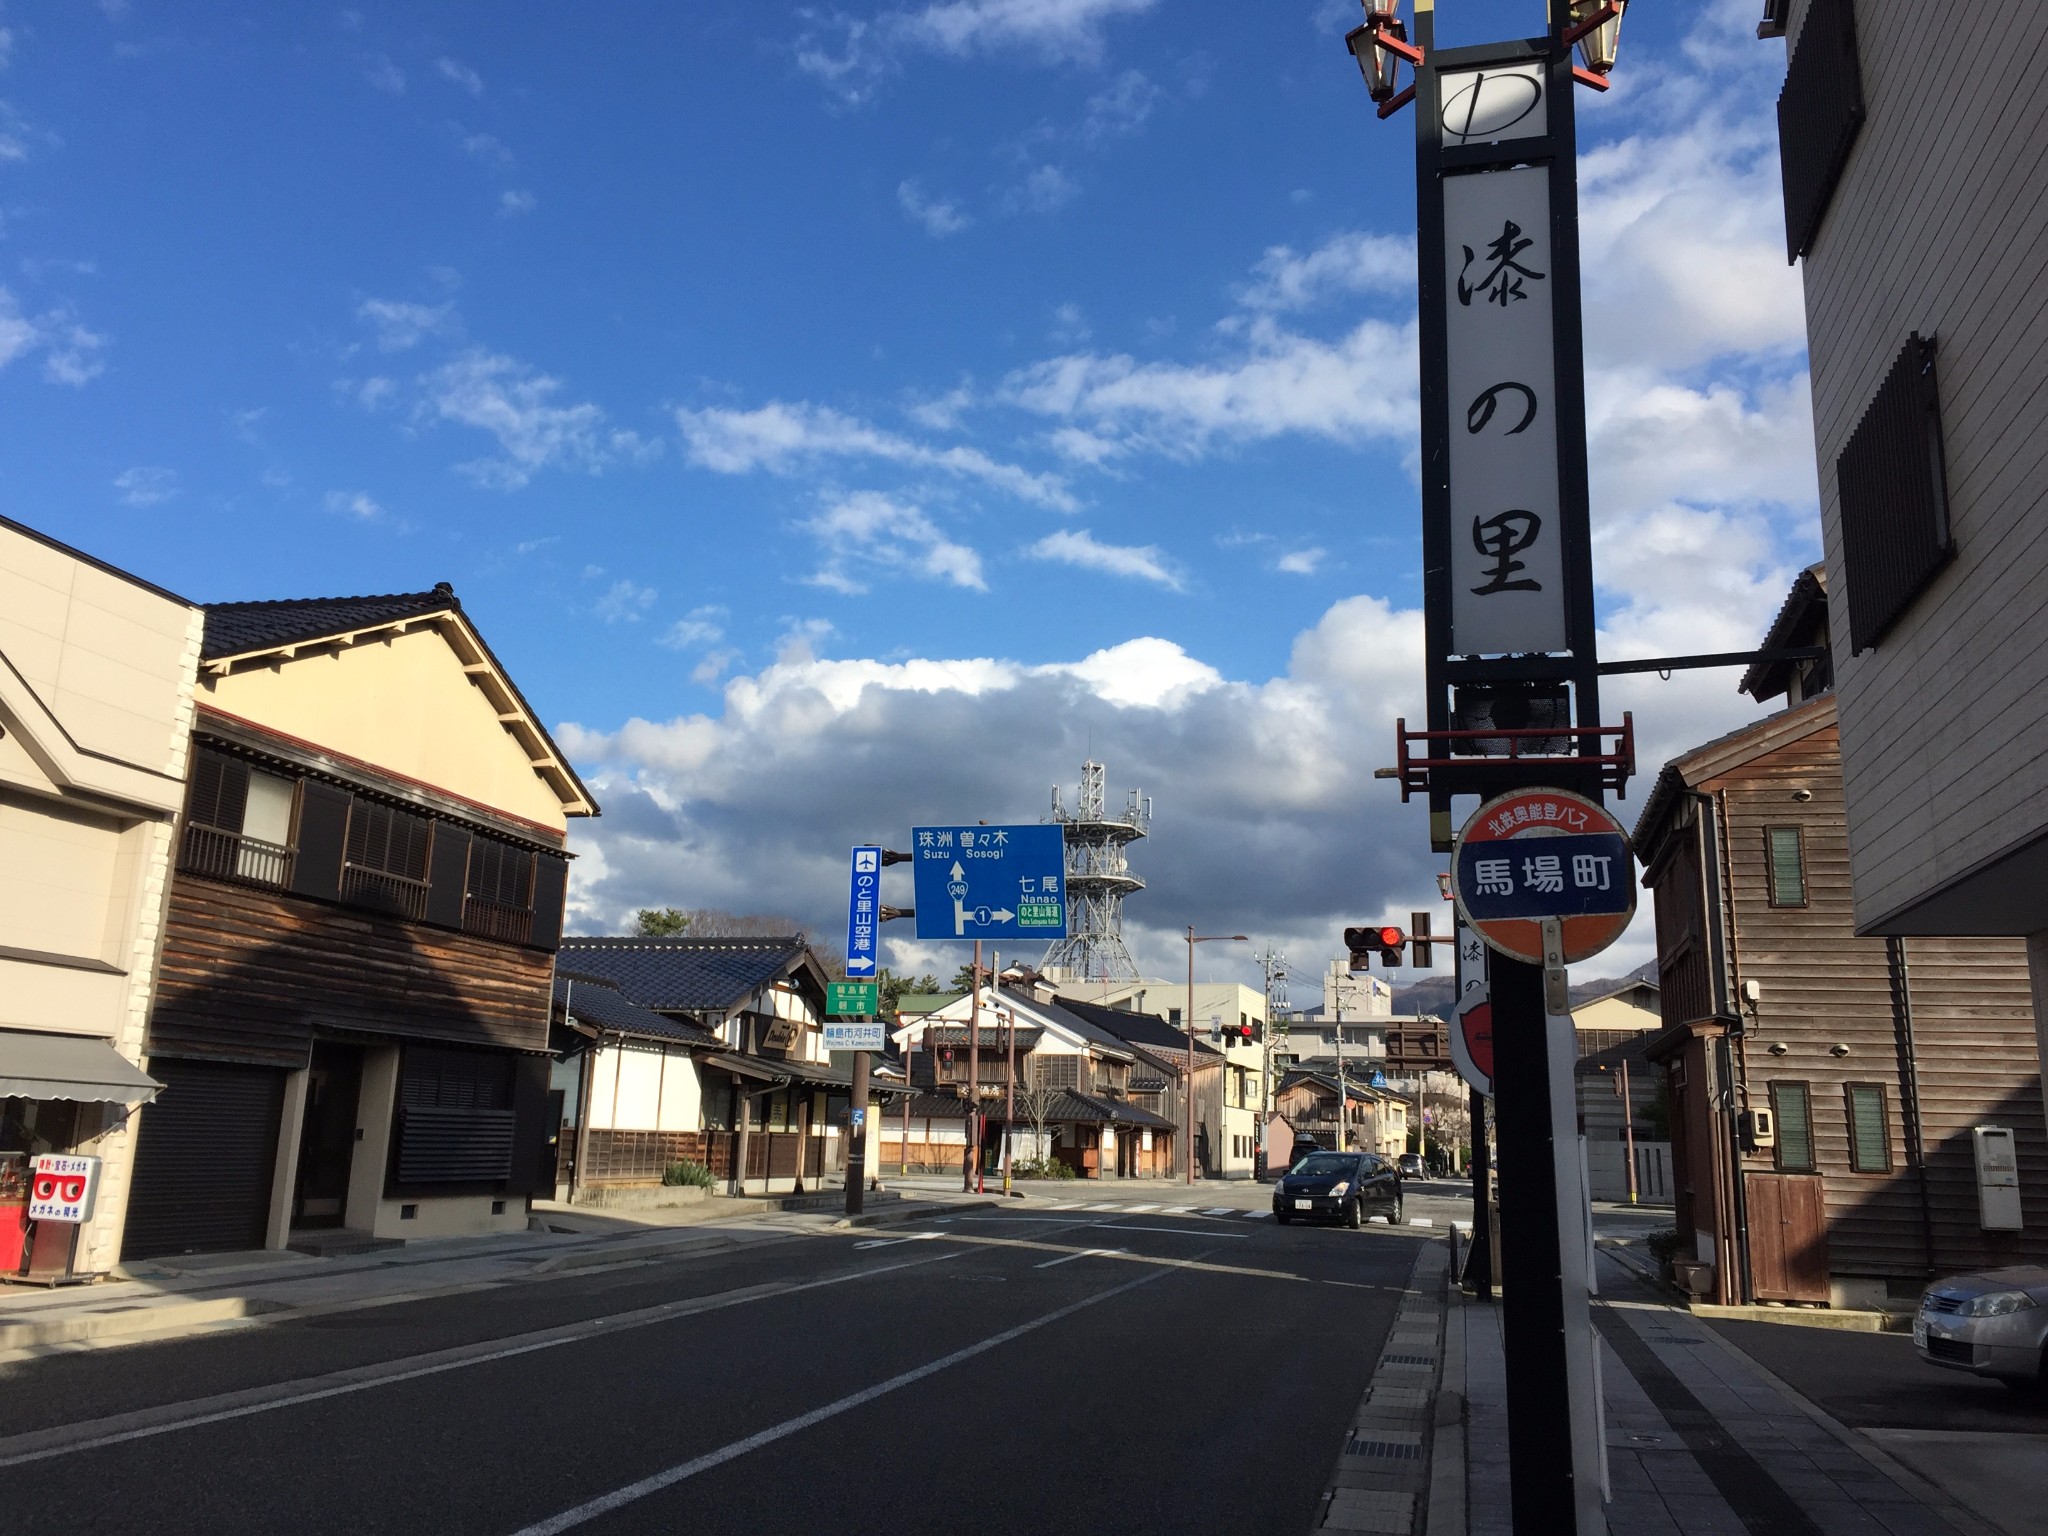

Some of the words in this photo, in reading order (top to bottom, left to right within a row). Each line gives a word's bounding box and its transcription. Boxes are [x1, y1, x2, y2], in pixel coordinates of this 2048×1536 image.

[1455, 218, 1546, 597] 漆の里
[1488, 802, 1589, 837] 北鉄奥能登バス
[918, 831, 953, 848] 珠洲
[960, 829, 1009, 848] 曽々木
[923, 850, 950, 859] Suzu
[965, 848, 1004, 860] Sosogi
[1474, 854, 1612, 896] 馬場町
[1018, 875, 1059, 893] 七尾
[950, 885, 966, 896] 249
[1020, 894, 1058, 904] Nanao
[853, 875, 874, 951] のと里山空港
[979, 910, 986, 922] 1
[1020, 906, 1059, 918] のと里山海道
[836, 985, 868, 995] 輪島駅
[826, 1027, 881, 1039] 輪島市河井町
